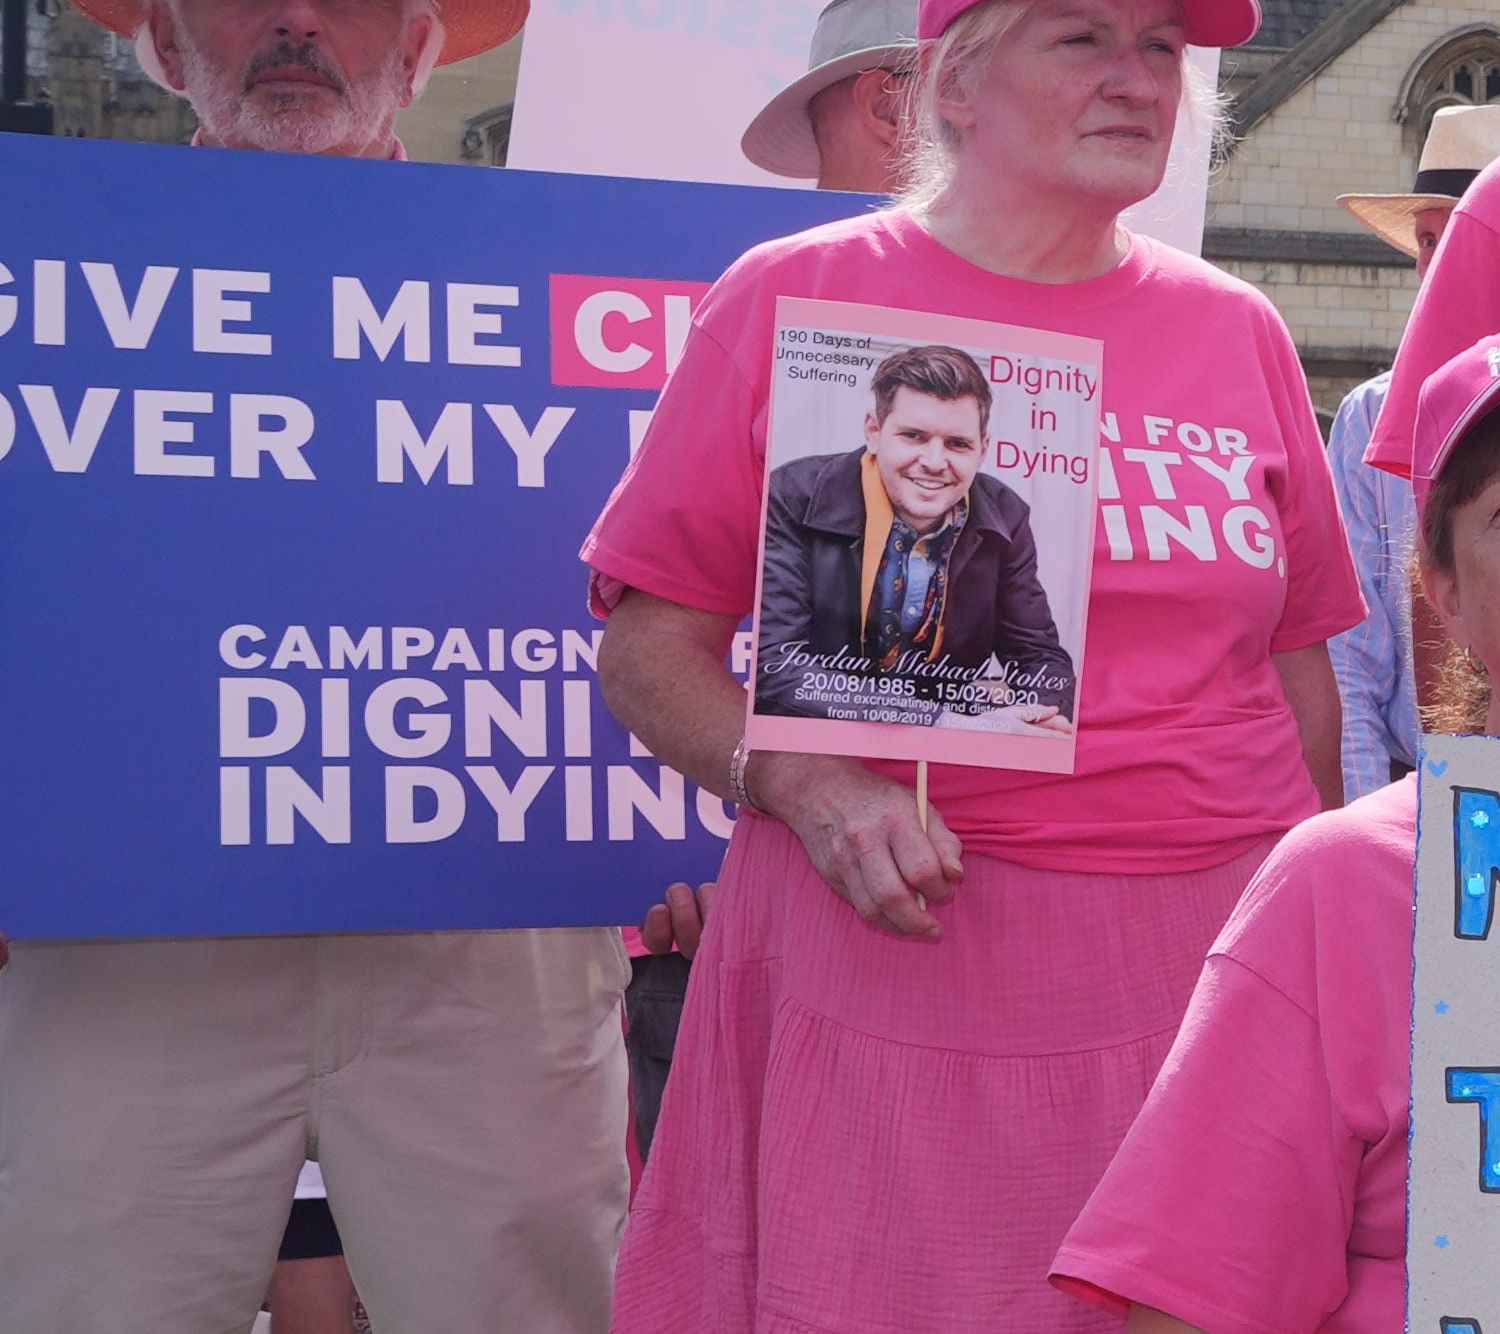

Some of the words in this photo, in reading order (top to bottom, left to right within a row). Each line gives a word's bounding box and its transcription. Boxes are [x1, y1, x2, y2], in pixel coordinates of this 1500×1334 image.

[0, 258, 273, 357] IVE
[333, 276, 523, 369] ME
[776, 347, 875, 371] Unnecessary
[779, 330, 808, 344] 190
[812, 332, 852, 349] Days
[856, 337, 872, 349] of
[787, 365, 857, 388] Suffering
[989, 354, 1097, 401] Dignity
[0, 383, 316, 481] VER
[376, 400, 577, 489] MY
[1030, 402, 1057, 432] in
[1142, 414, 1254, 457] FOR
[996, 441, 1089, 485] Dying
[219, 623, 604, 673] CAMPAIGN
[764, 640, 872, 674] Jordan
[880, 650, 992, 682] Michael
[989, 659, 1070, 692] Stokes
[795, 687, 851, 704] Suffered
[942, 701, 967, 714] and
[802, 672, 916, 697] 20/08/1985
[935, 682, 1039, 708] 15/02/2020
[827, 706, 858, 720] from
[219, 764, 352, 847] IN
